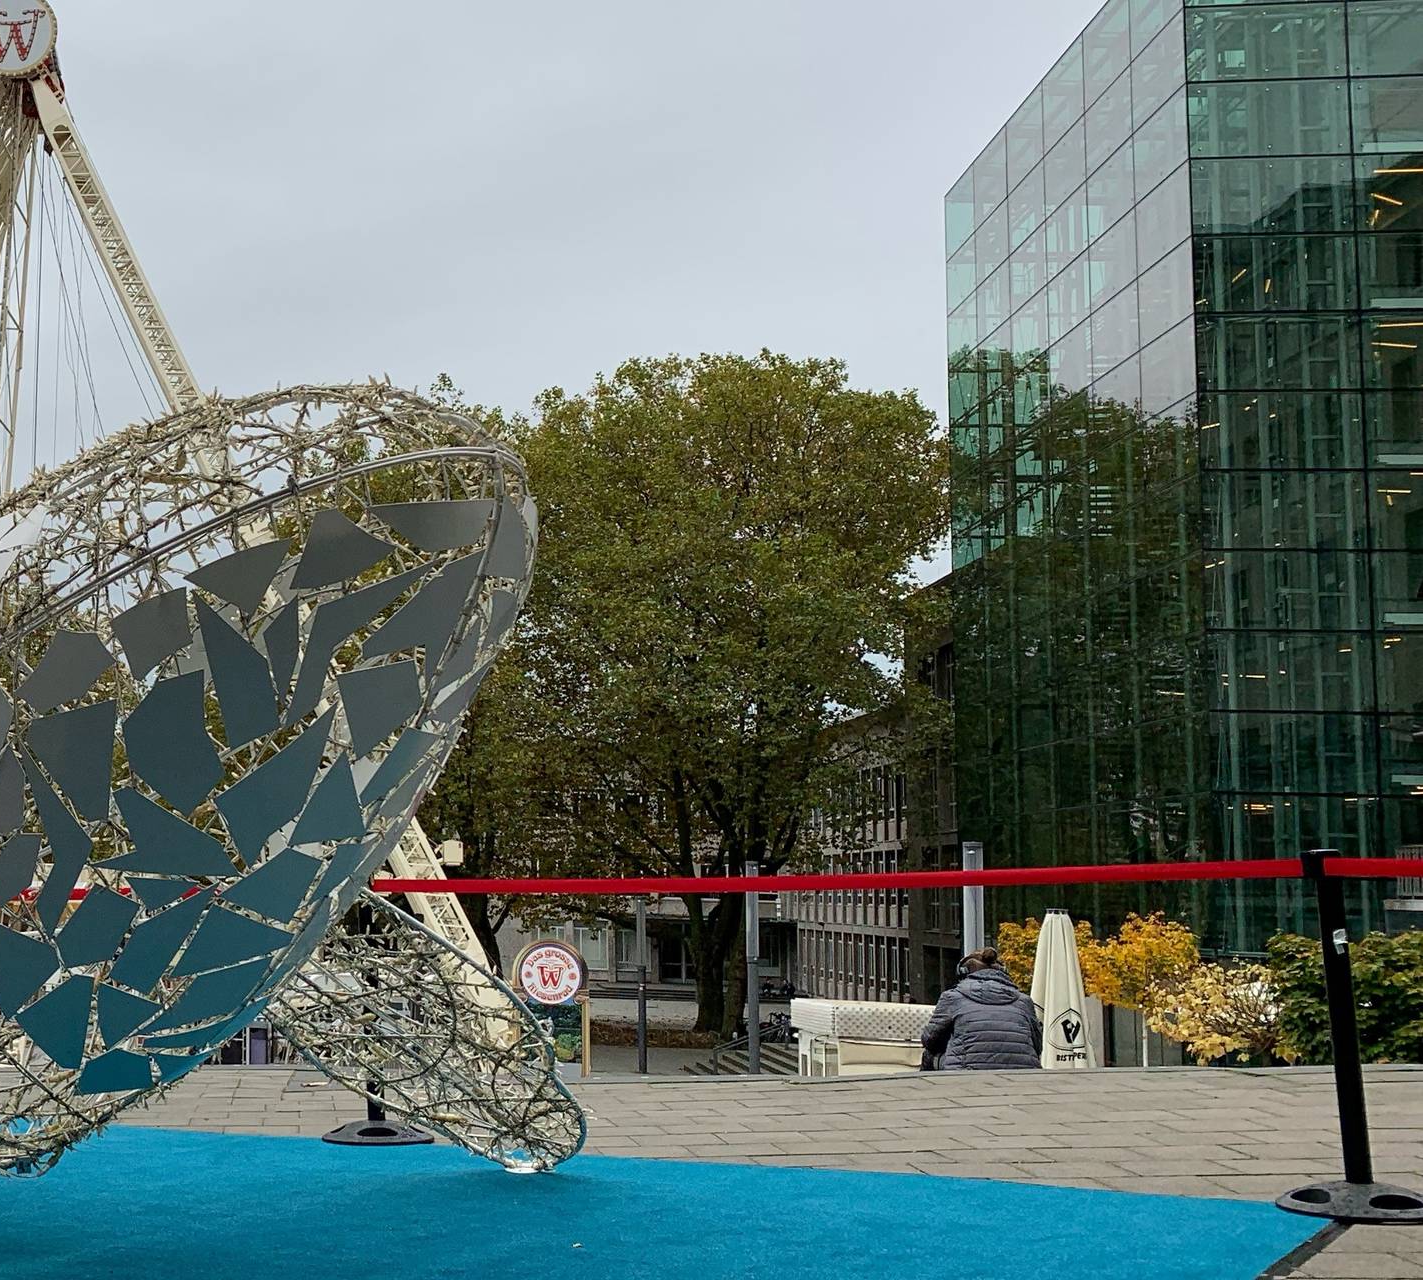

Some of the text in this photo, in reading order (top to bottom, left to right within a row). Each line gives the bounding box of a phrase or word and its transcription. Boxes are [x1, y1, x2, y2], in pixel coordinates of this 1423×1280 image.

[526, 949, 574, 970] Das grosse
[536, 964, 564, 988] W
[528, 982, 573, 1001] Riesenrad
